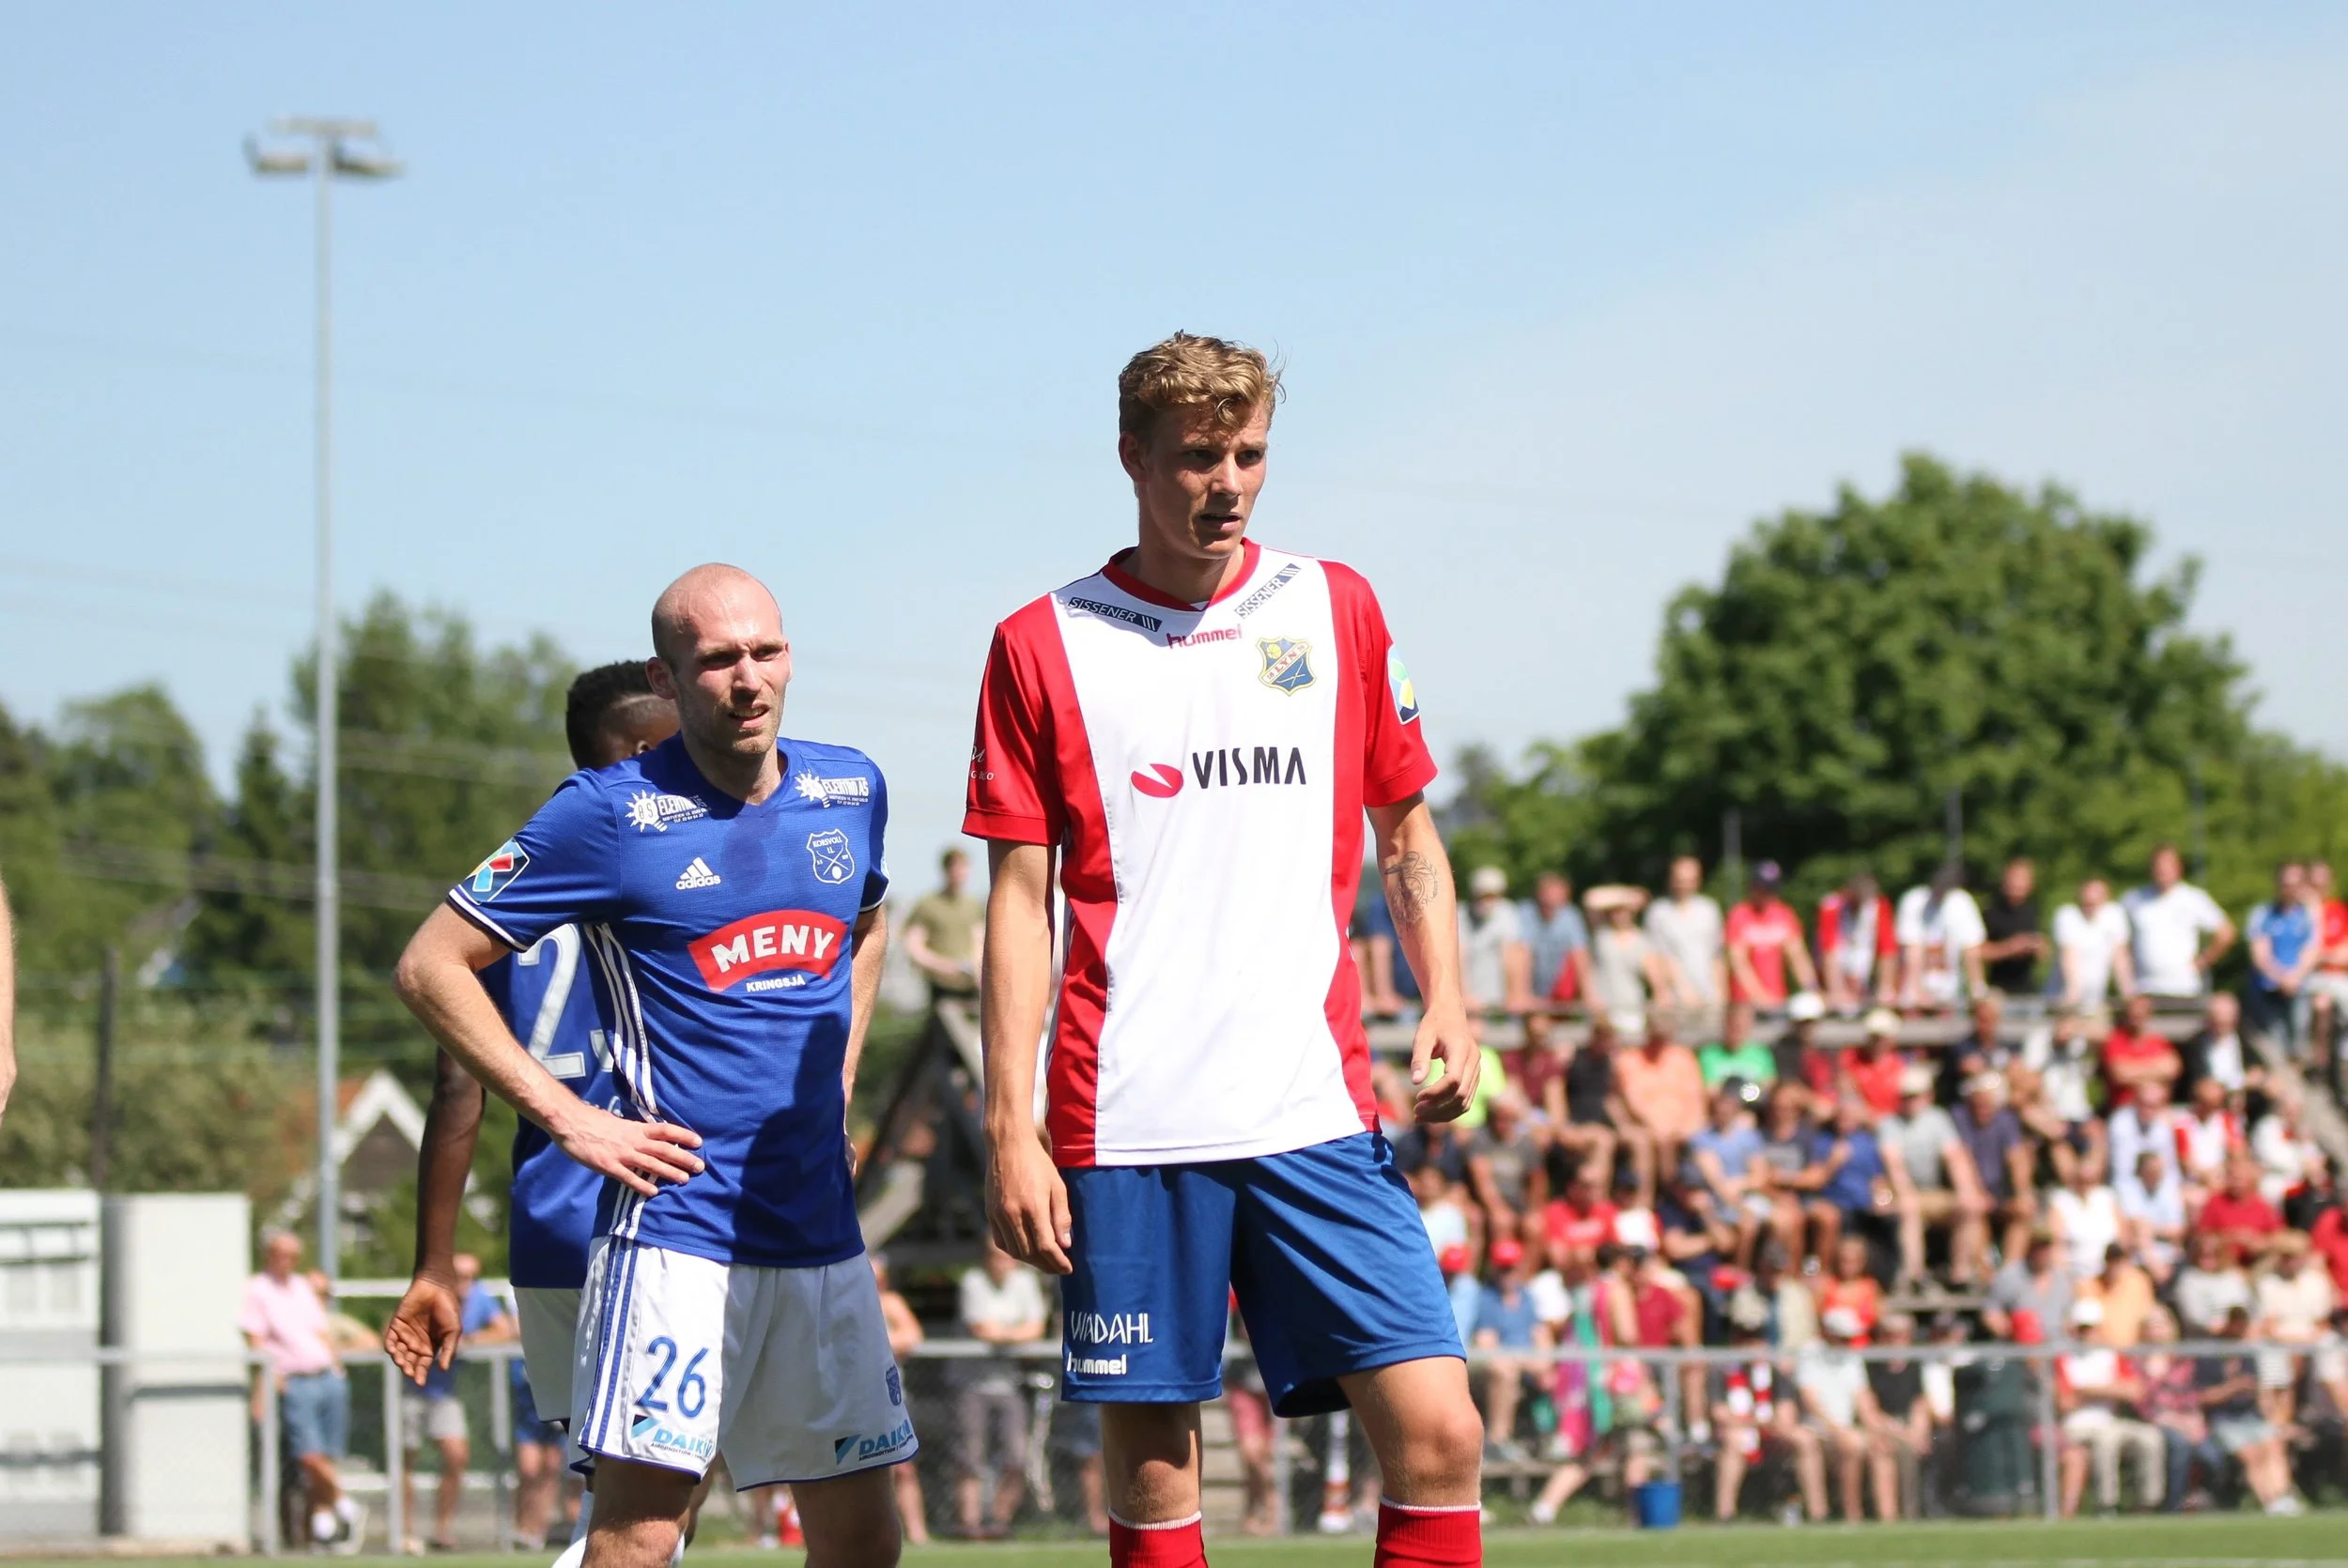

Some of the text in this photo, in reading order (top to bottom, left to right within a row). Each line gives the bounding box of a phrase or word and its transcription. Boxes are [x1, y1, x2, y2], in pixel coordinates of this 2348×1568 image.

[1070, 598, 1136, 623] SISSENER
[1235, 576, 1285, 619] SISSENER
[1166, 623, 1243, 649] hummel
[1192, 746, 1306, 789] VISMA
[675, 875, 721, 890] adidas
[711, 925, 834, 973] MENY
[1071, 1311, 1154, 1345] WADAHL
[635, 1336, 709, 1419] 26
[1067, 1352, 1126, 1375] hummel
